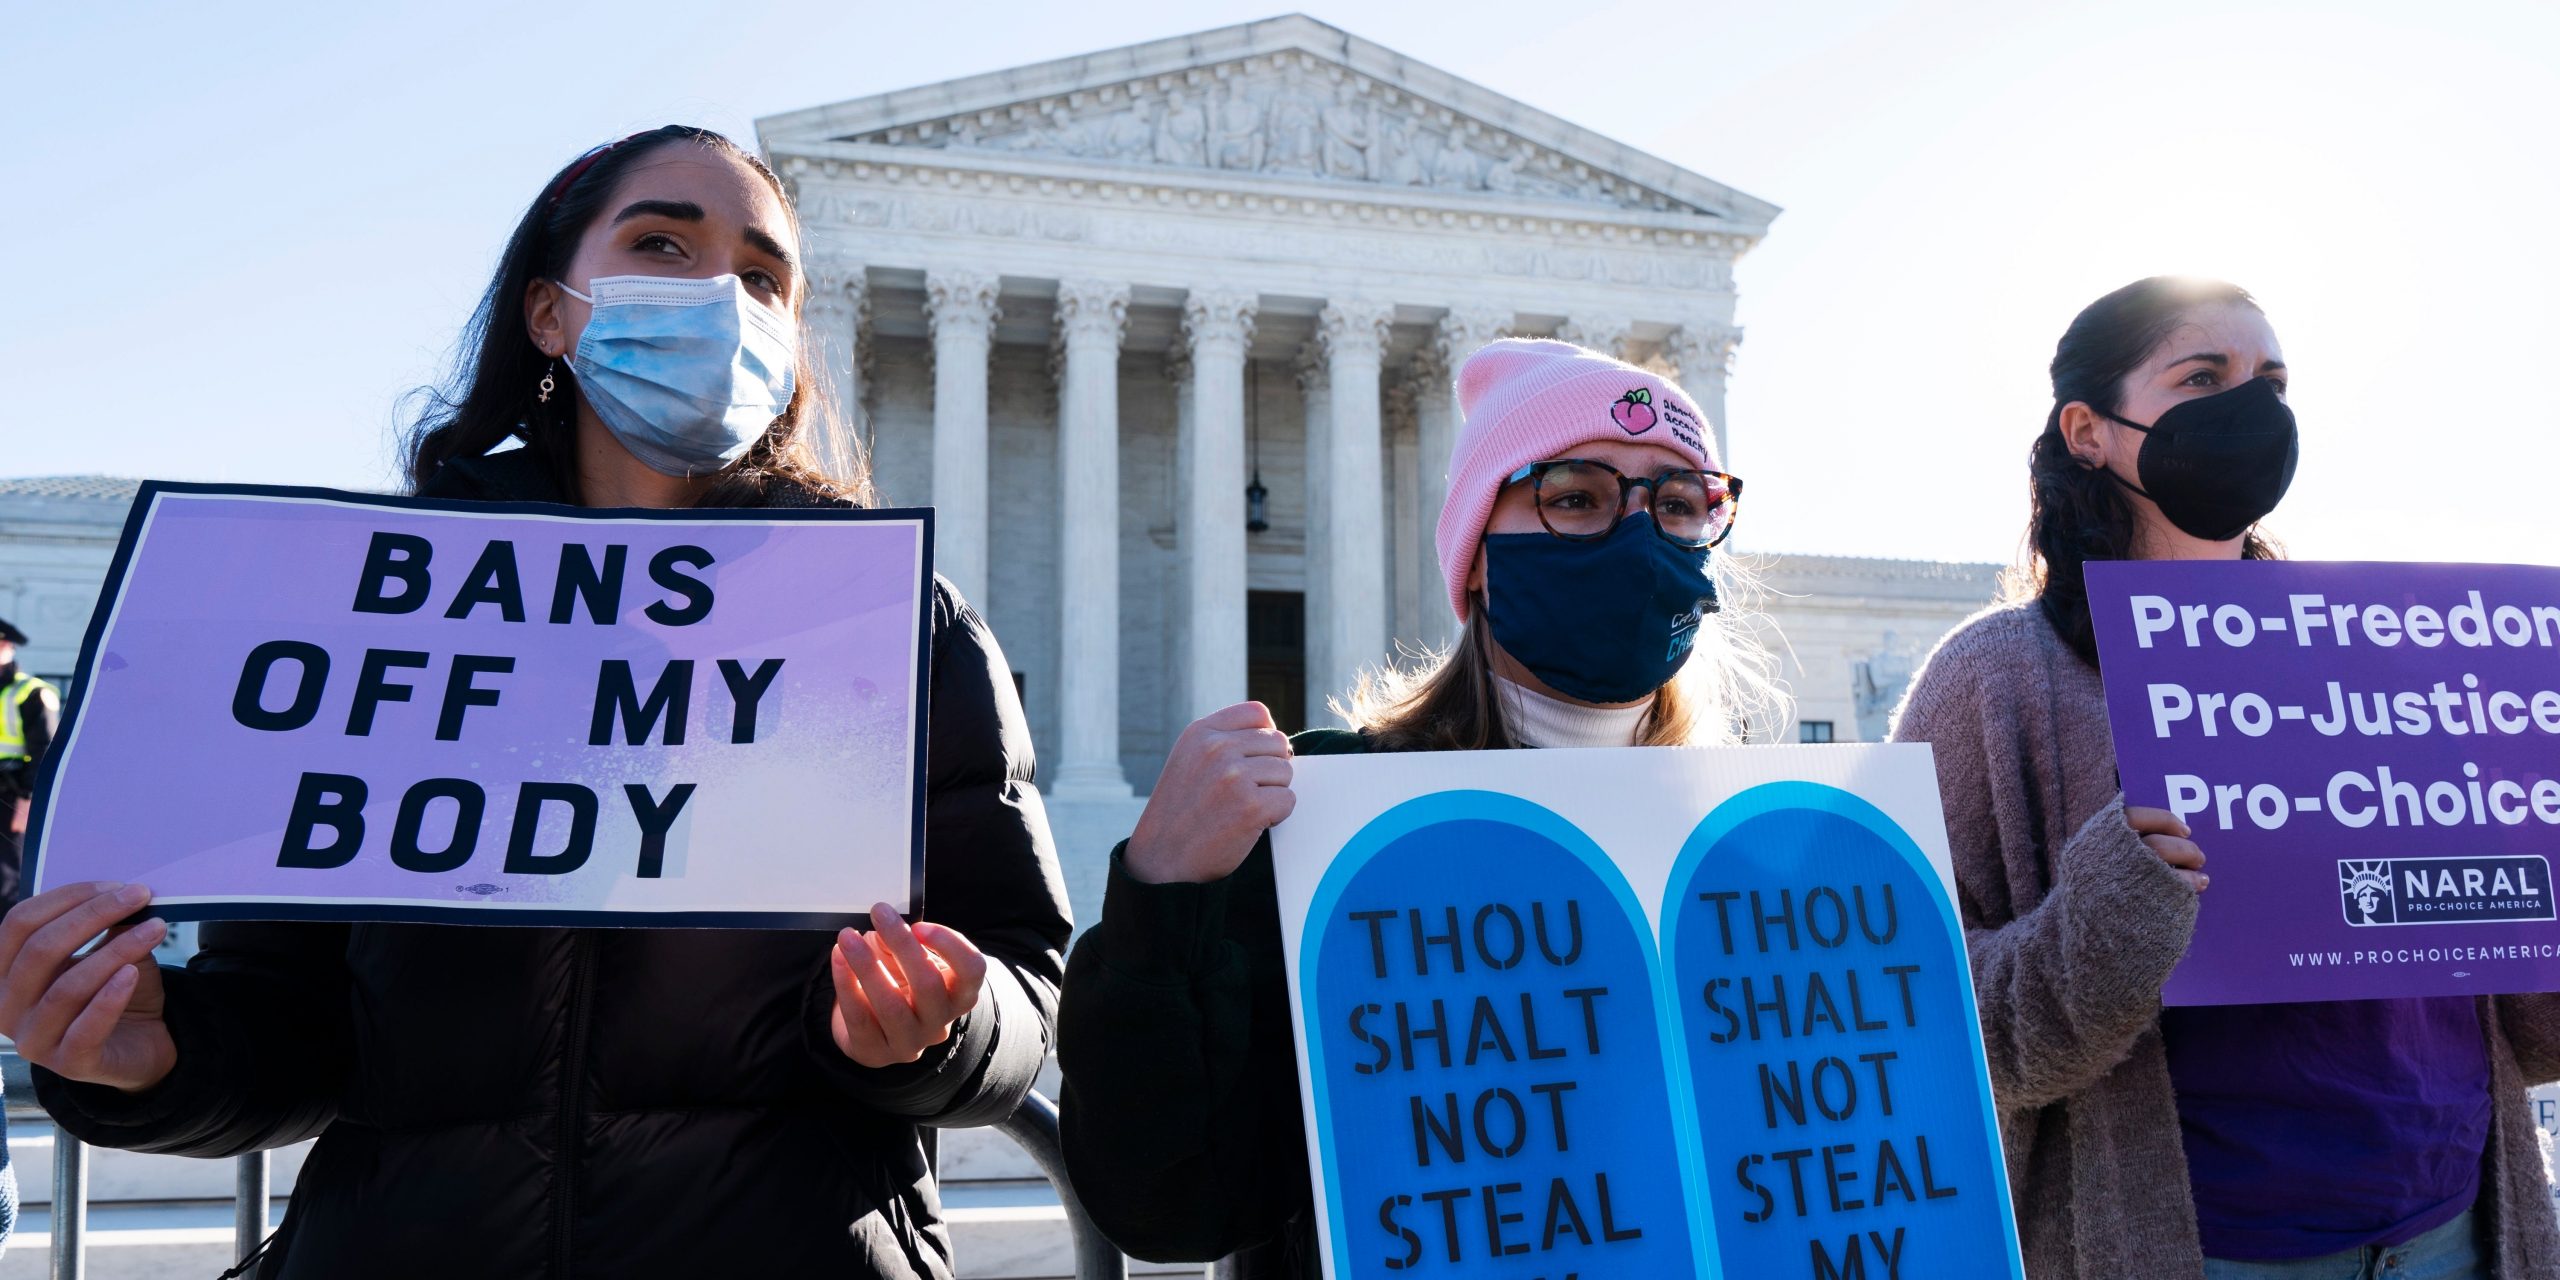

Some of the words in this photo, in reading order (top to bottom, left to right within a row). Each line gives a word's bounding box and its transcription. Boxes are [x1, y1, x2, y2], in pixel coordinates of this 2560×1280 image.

[352, 532, 715, 626] BANS
[232, 641, 515, 741] OFF
[588, 659, 785, 745] MY
[2147, 673, 2560, 738] Pro-Justice
[276, 772, 697, 878] BODY
[2164, 762, 2560, 830] Pro-Choice
[1699, 884, 1898, 955] THOU
[2404, 868, 2539, 898] NARAL
[2408, 902, 2484, 911] PRO-CHOICE
[2489, 900, 2541, 909] AMERICA
[1349, 900, 1583, 978] THOU
[1349, 987, 1609, 1075] SHALT
[1703, 965, 1921, 1044] SHALT
[1409, 1081, 1577, 1167] NOT
[1758, 1051, 1897, 1129] NOT
[1736, 1135, 1958, 1223] STEAL
[1378, 1172, 1642, 1271] STEAL
[1809, 1227, 1905, 1280] MY
